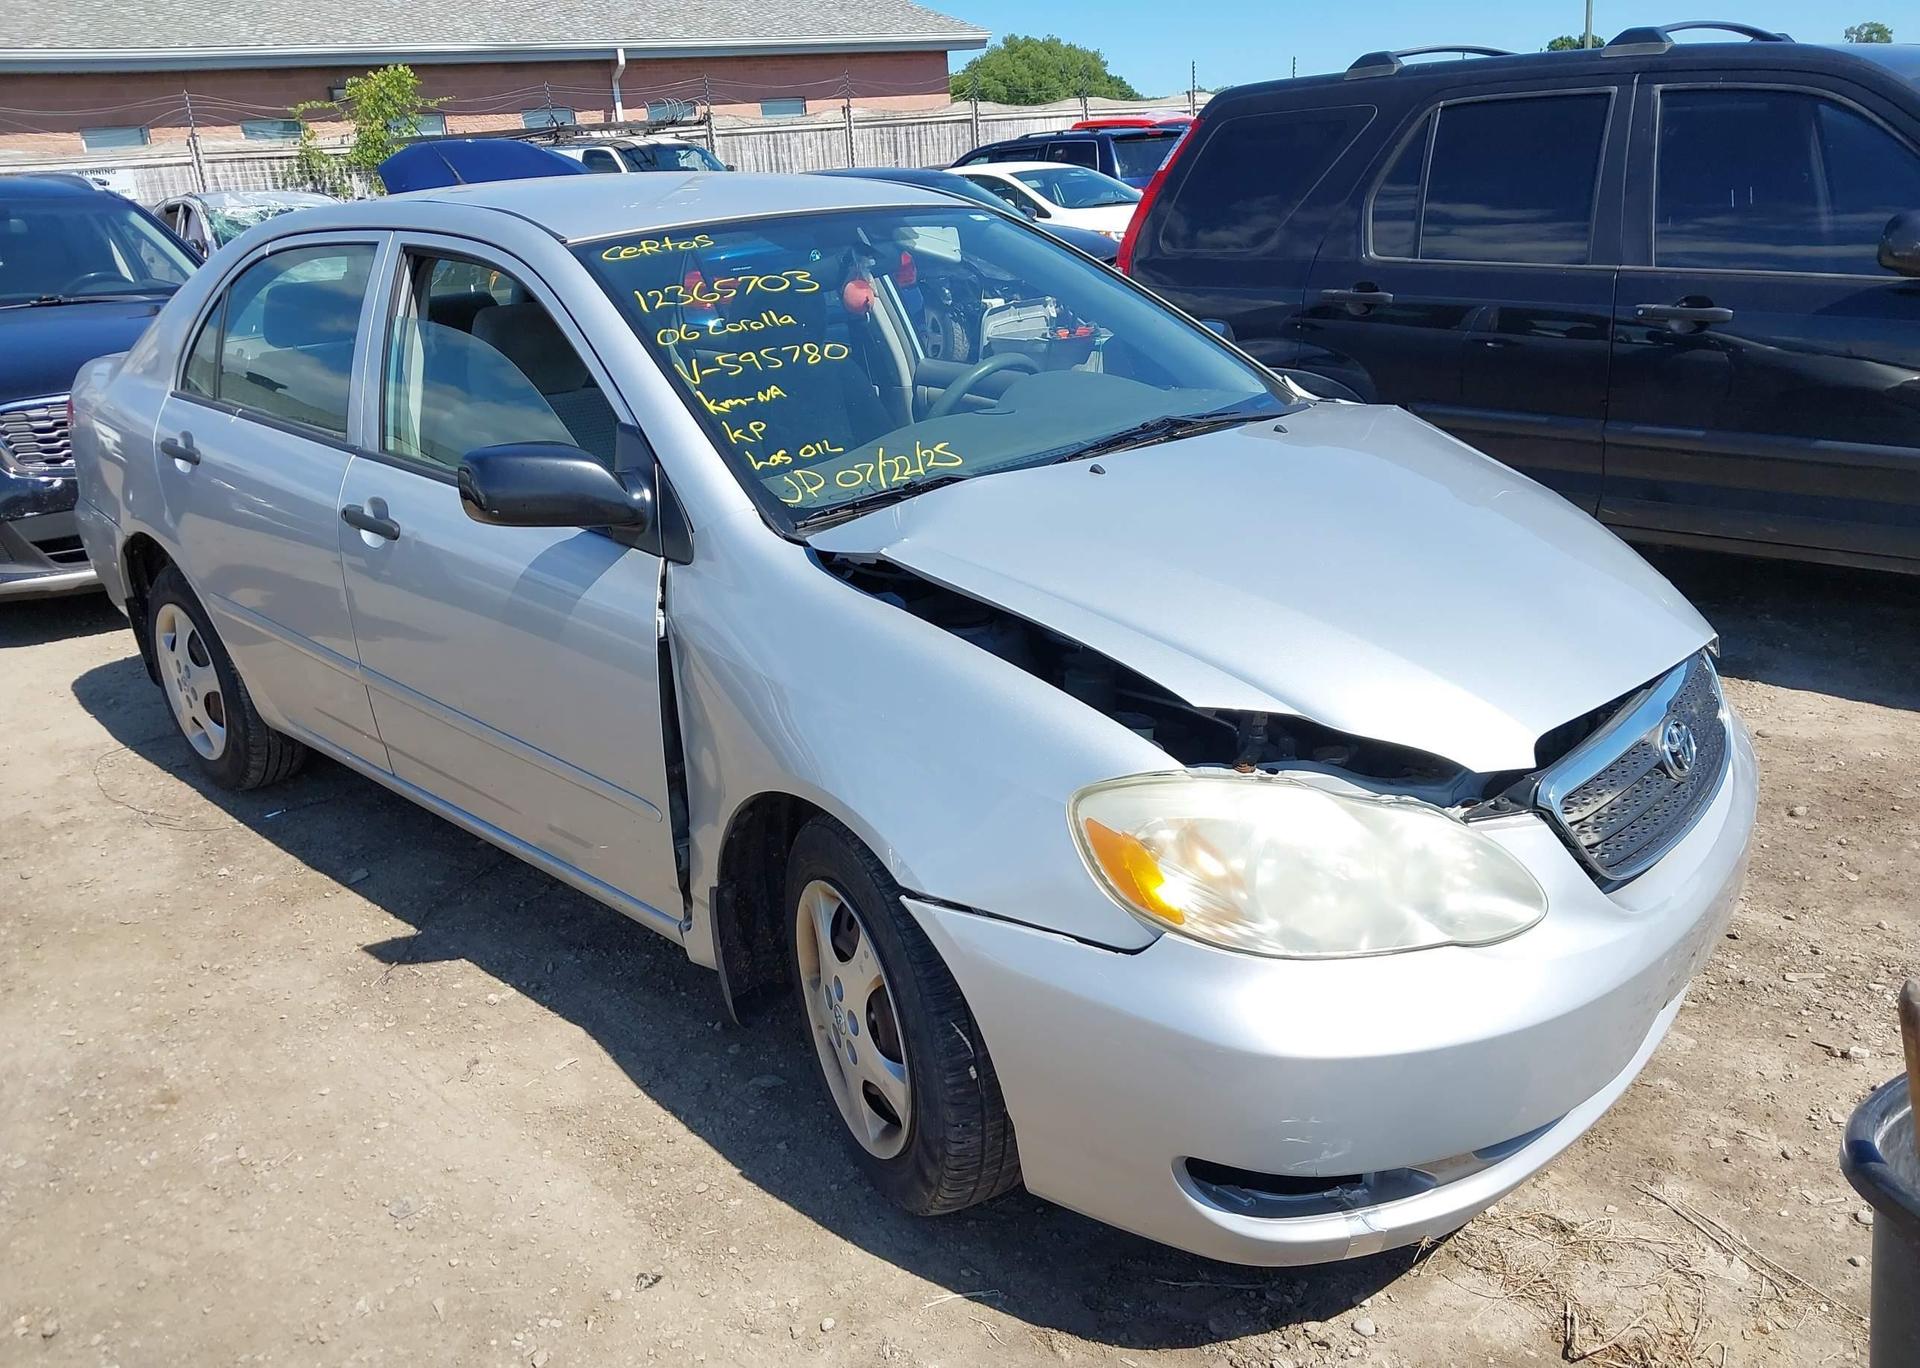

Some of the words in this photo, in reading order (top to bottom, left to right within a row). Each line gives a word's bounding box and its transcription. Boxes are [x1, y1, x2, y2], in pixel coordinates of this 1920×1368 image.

[77, 168, 117, 177] WARNING
[634, 271, 820, 313] 12365703
[656, 323, 700, 346] 06
[673, 342, 849, 386] V-595780
